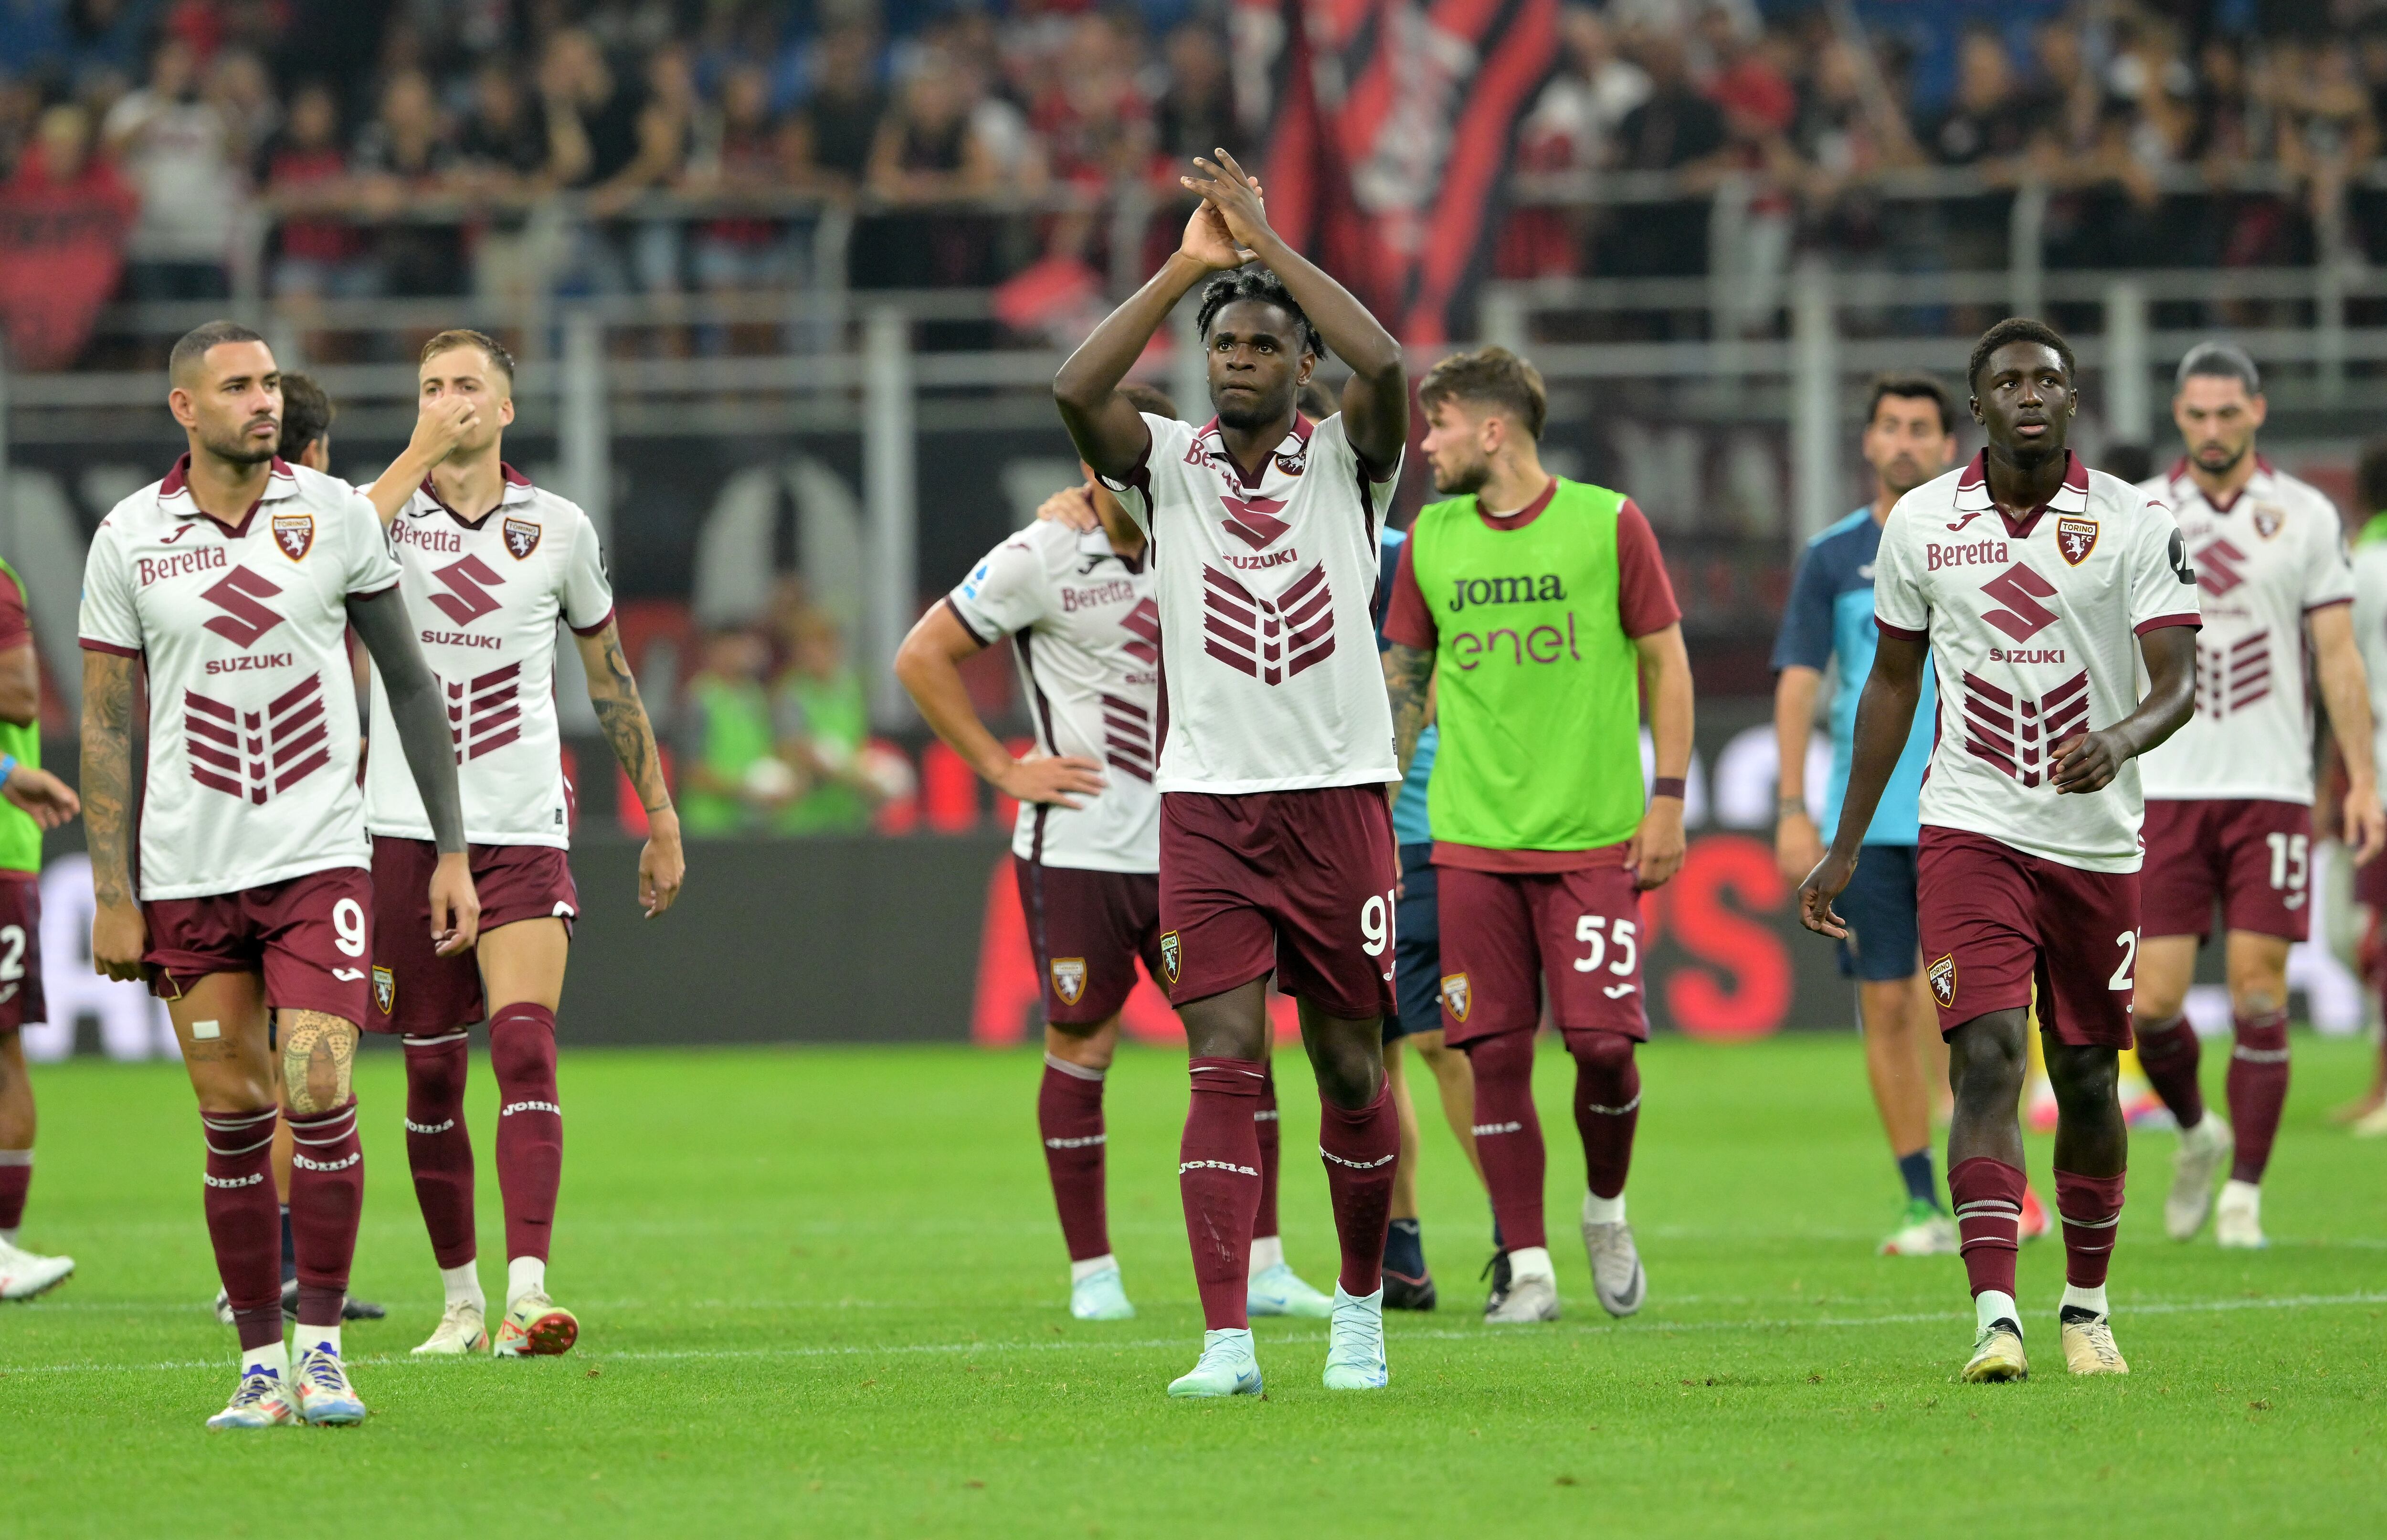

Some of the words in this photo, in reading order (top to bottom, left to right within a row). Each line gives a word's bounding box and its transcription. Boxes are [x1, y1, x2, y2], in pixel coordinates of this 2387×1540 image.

[391, 519, 461, 552] Beretta
[2063, 523, 2093, 533] TORINO
[138, 545, 227, 586] Beretta
[1222, 548, 1298, 570] UZUKI
[1926, 538, 2008, 571] Beretta
[1061, 580, 1135, 612] Beretta
[422, 630, 502, 650] SUZUKI
[1453, 611, 1581, 671] enel
[1989, 648, 2065, 664] SUZUKI
[205, 653, 293, 674] SUZUKI
[2266, 832, 2309, 890] 15
[333, 897, 366, 958] 9
[1574, 915, 1637, 976] 55
[1930, 962, 1950, 978] TORINO
[1943, 970, 1953, 980] FC
